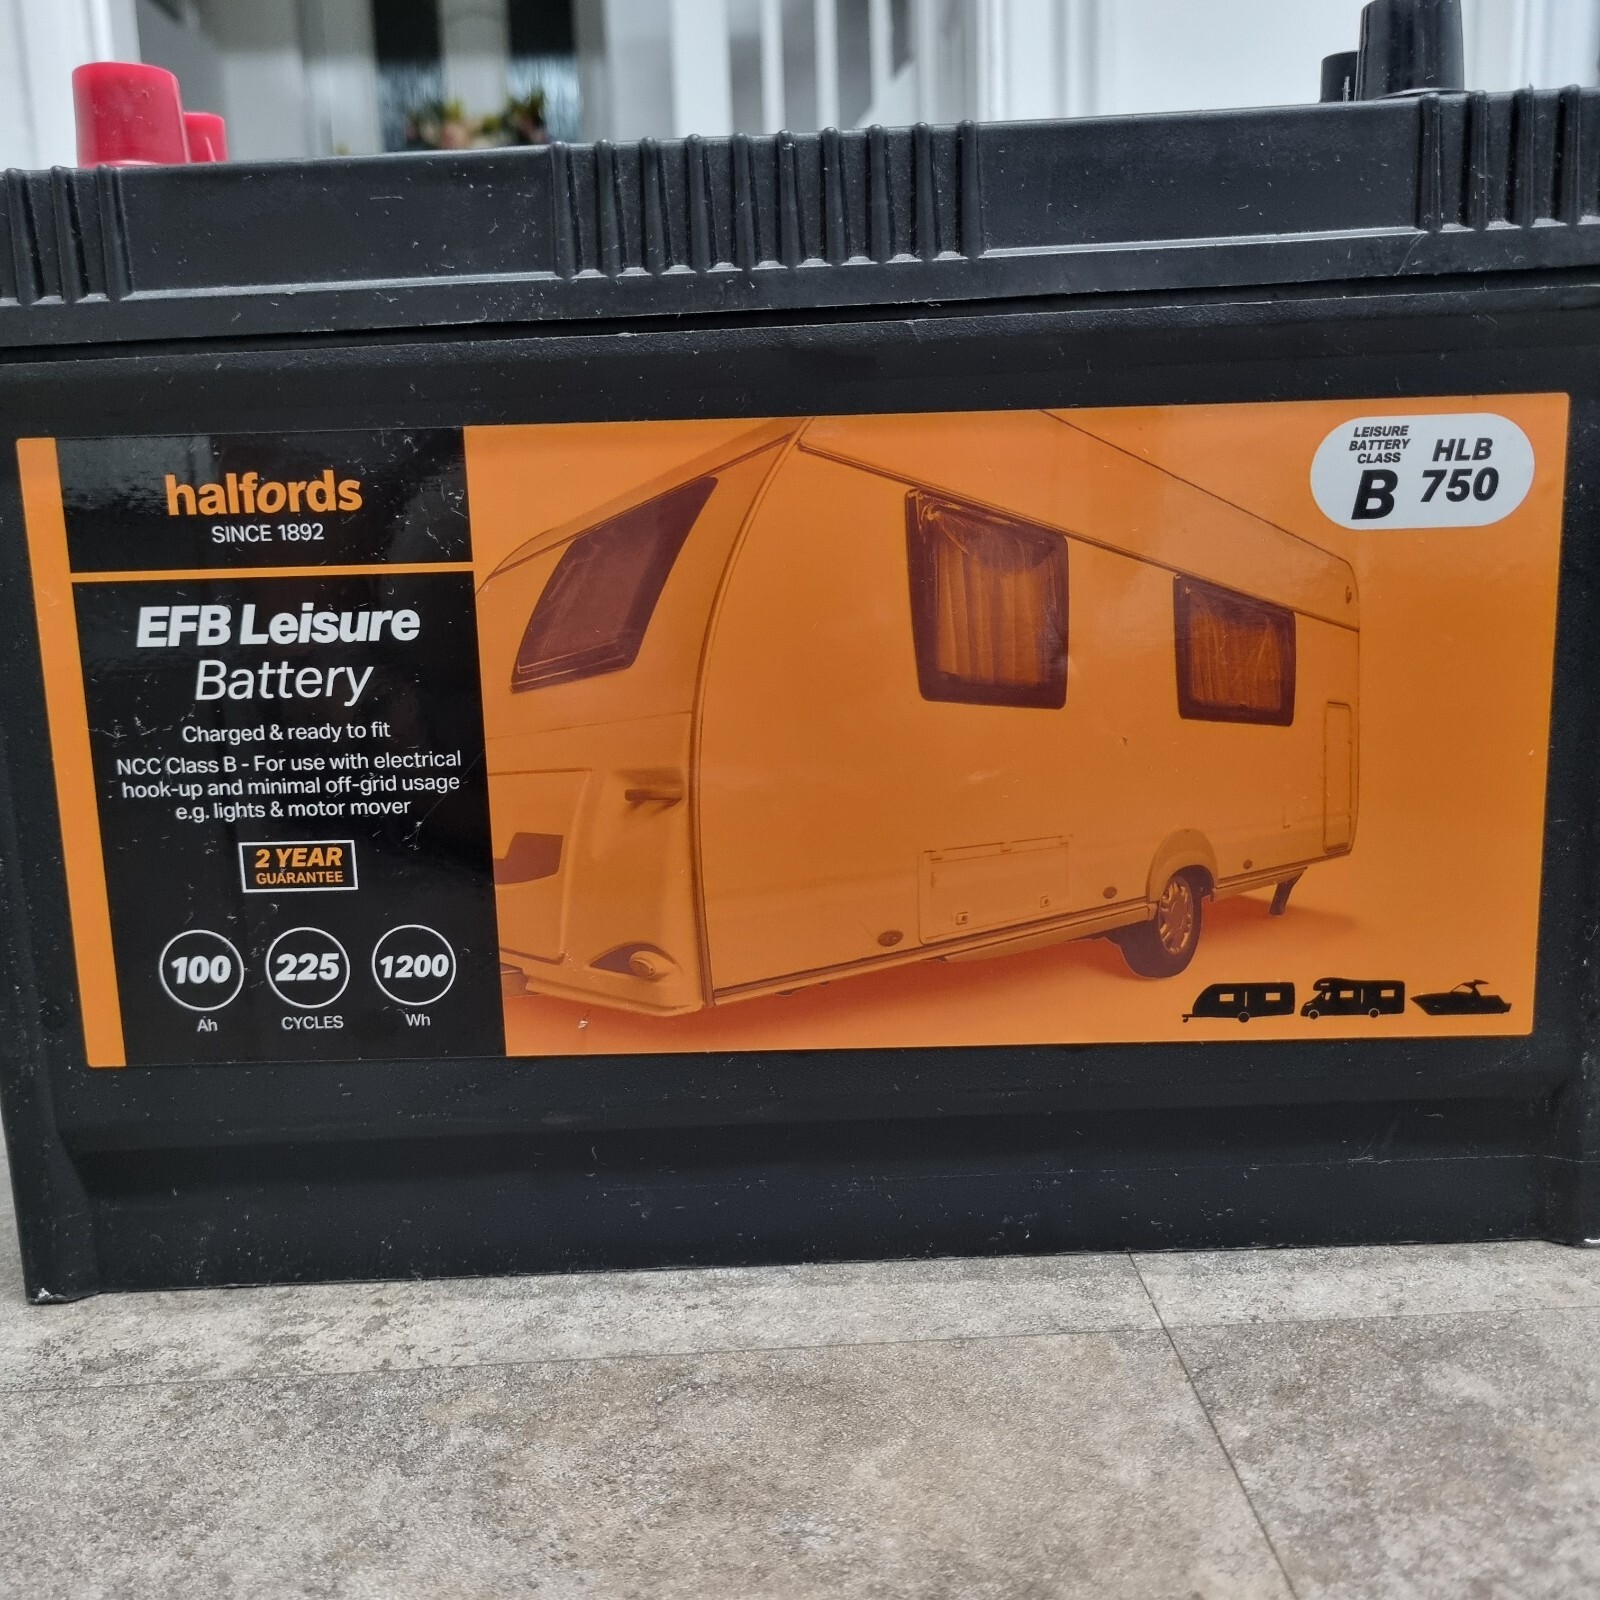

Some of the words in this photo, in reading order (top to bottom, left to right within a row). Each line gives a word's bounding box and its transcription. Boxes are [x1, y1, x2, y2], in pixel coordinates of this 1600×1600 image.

[1354, 425, 1409, 437] LEISURE
[1349, 438, 1410, 451] BATTERY
[1432, 438, 1493, 462] HLB
[1357, 452, 1401, 464] CLASS
[165, 469, 362, 516] halfords
[1351, 469, 1398, 519] B
[1420, 467, 1499, 502] 750
[212, 525, 271, 543] SINCE
[278, 523, 324, 541] 1892
[136, 605, 231, 647] EFB
[240, 603, 420, 645] Leisure
[195, 658, 374, 707] Battery
[183, 724, 265, 745] Charged
[270, 725, 283, 740] &
[288, 724, 341, 743] ready
[346, 724, 367, 738] to
[371, 722, 391, 738] fit
[117, 759, 161, 775] NCC
[166, 757, 218, 774] Class
[224, 756, 237, 772] B
[254, 756, 286, 772] For
[291, 757, 325, 771] use
[329, 752, 369, 770] with
[374, 751, 461, 768] electrical
[122, 780, 203, 800] hook-up
[208, 778, 243, 795] and
[248, 777, 321, 794] minimal
[326, 774, 397, 796] off-grid
[402, 776, 460, 792] usage
[175, 806, 209, 822] e.g.
[214, 802, 266, 821] lights
[270, 802, 283, 817] &
[289, 801, 345, 816] motor
[351, 800, 411, 815] mover
[255, 850, 271, 869] 2
[277, 847, 342, 867] YEAR
[256, 871, 344, 885] GUARANTEE
[171, 956, 231, 984] 100
[275, 953, 340, 981] 225
[379, 954, 449, 979] 1200
[197, 1018, 218, 1033] Ah
[281, 1015, 344, 1030] CYCLES
[405, 1013, 431, 1027] Wh
